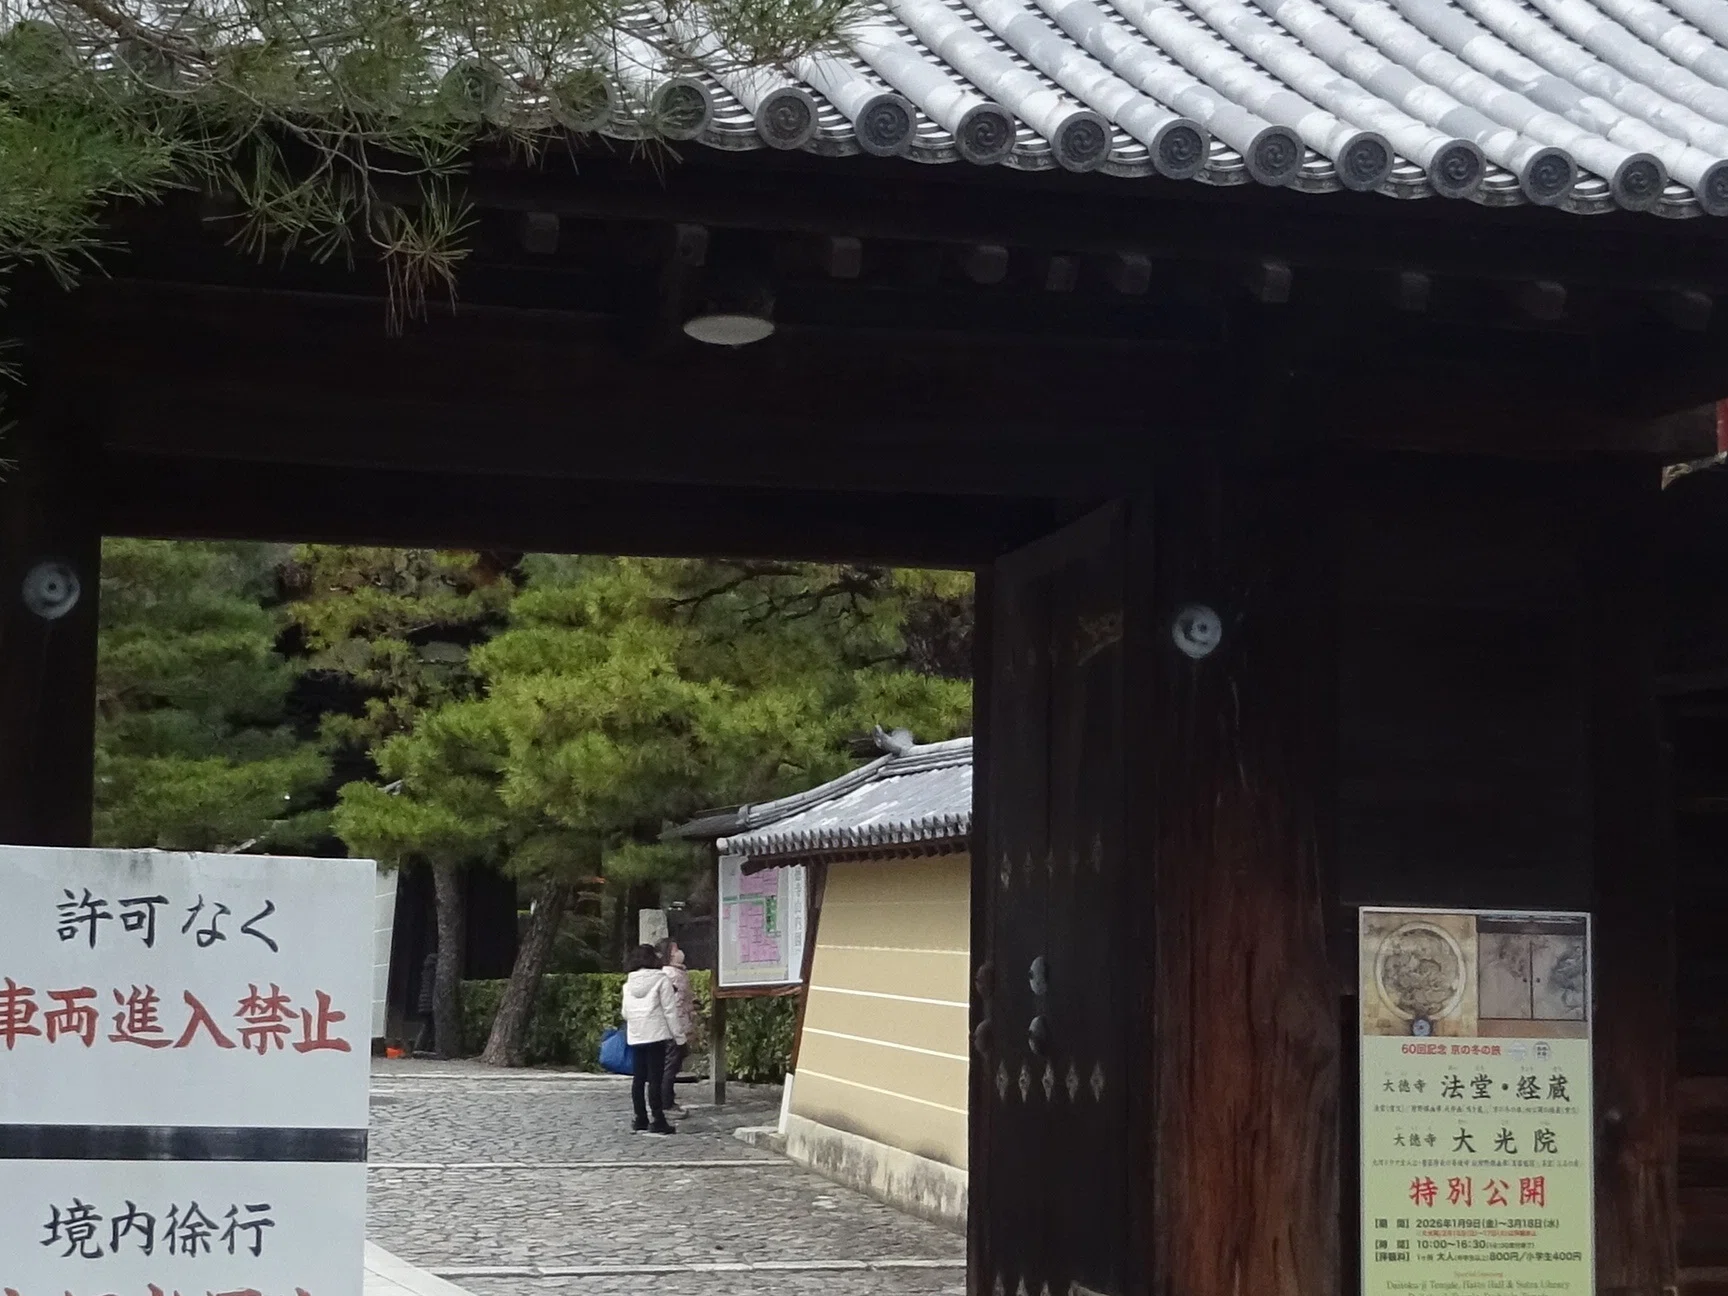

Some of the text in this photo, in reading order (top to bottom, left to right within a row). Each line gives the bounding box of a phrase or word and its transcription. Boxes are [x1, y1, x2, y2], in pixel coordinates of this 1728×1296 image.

[56, 888, 279, 952] 許可なく
[1401, 1044, 1502, 1056] 60回記念 京の冬の旅
[1382, 1073, 1570, 1102] 大徳寺 法堂・経蔵
[1393, 1127, 1558, 1154] 大徳寺 大光院
[1408, 1175, 1545, 1207] 特別公開
[39, 1197, 276, 1259] 境内徐行
